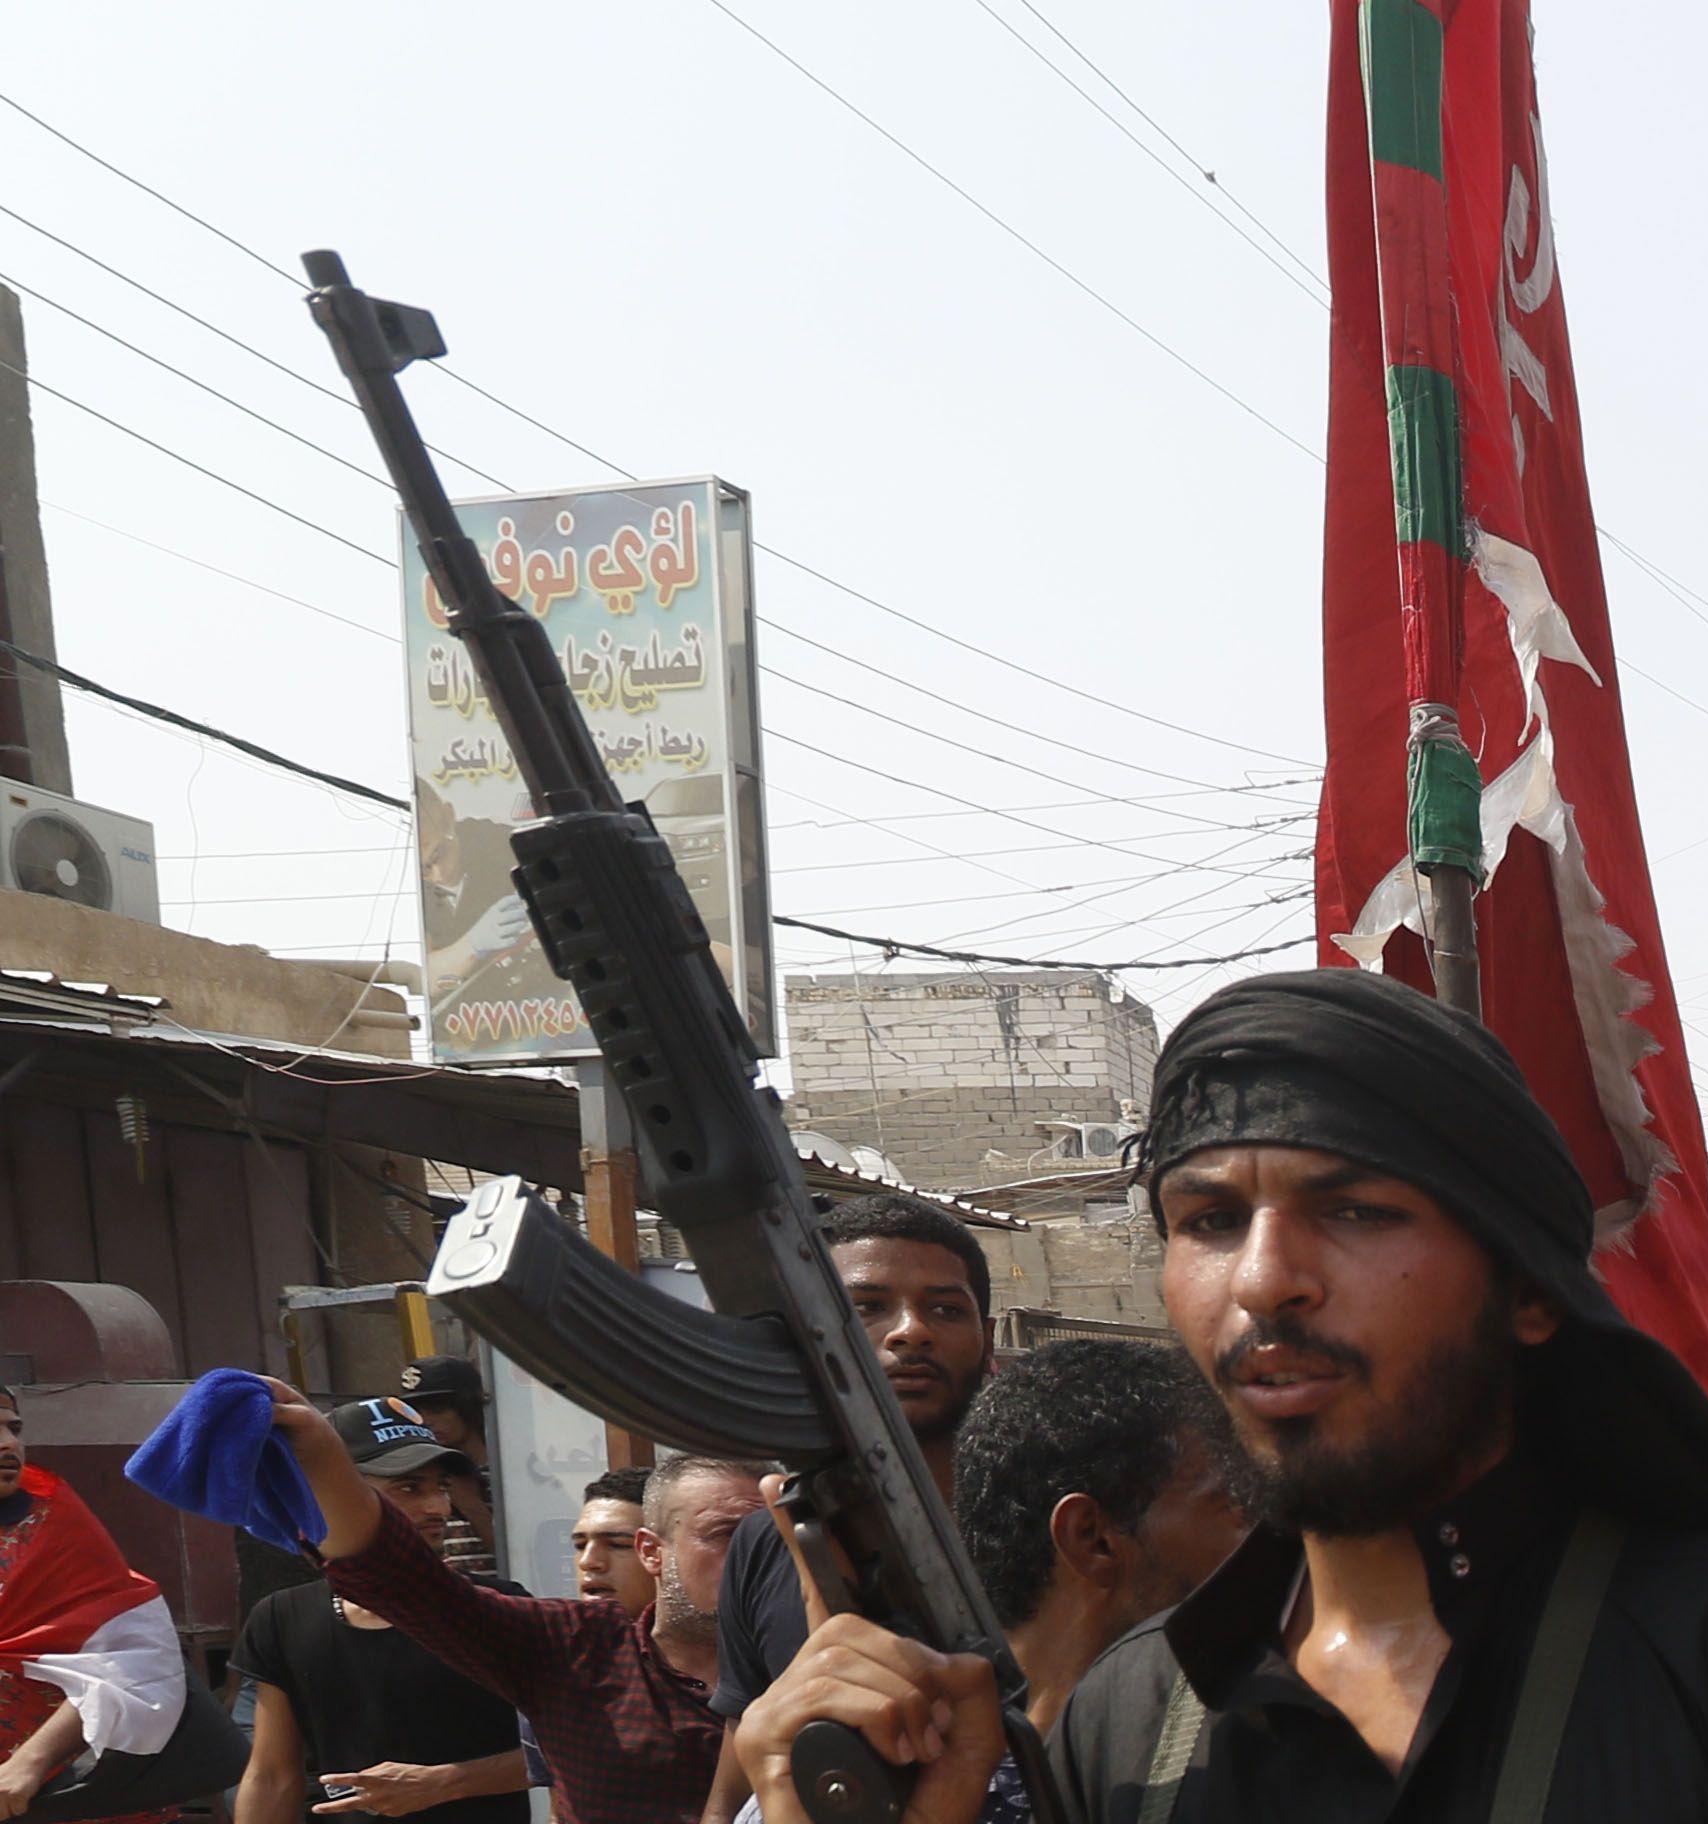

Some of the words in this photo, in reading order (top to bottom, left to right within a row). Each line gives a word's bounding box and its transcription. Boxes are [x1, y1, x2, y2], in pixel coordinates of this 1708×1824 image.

[588, 503, 697, 612] لؤي
[557, 630, 613, 708] زجا
[619, 626, 704, 713] تصليح
[433, 737, 495, 782] المبكر
[589, 722, 652, 767] أجهز
[658, 727, 707, 767] ربط
[358, 1399, 393, 1426] I
